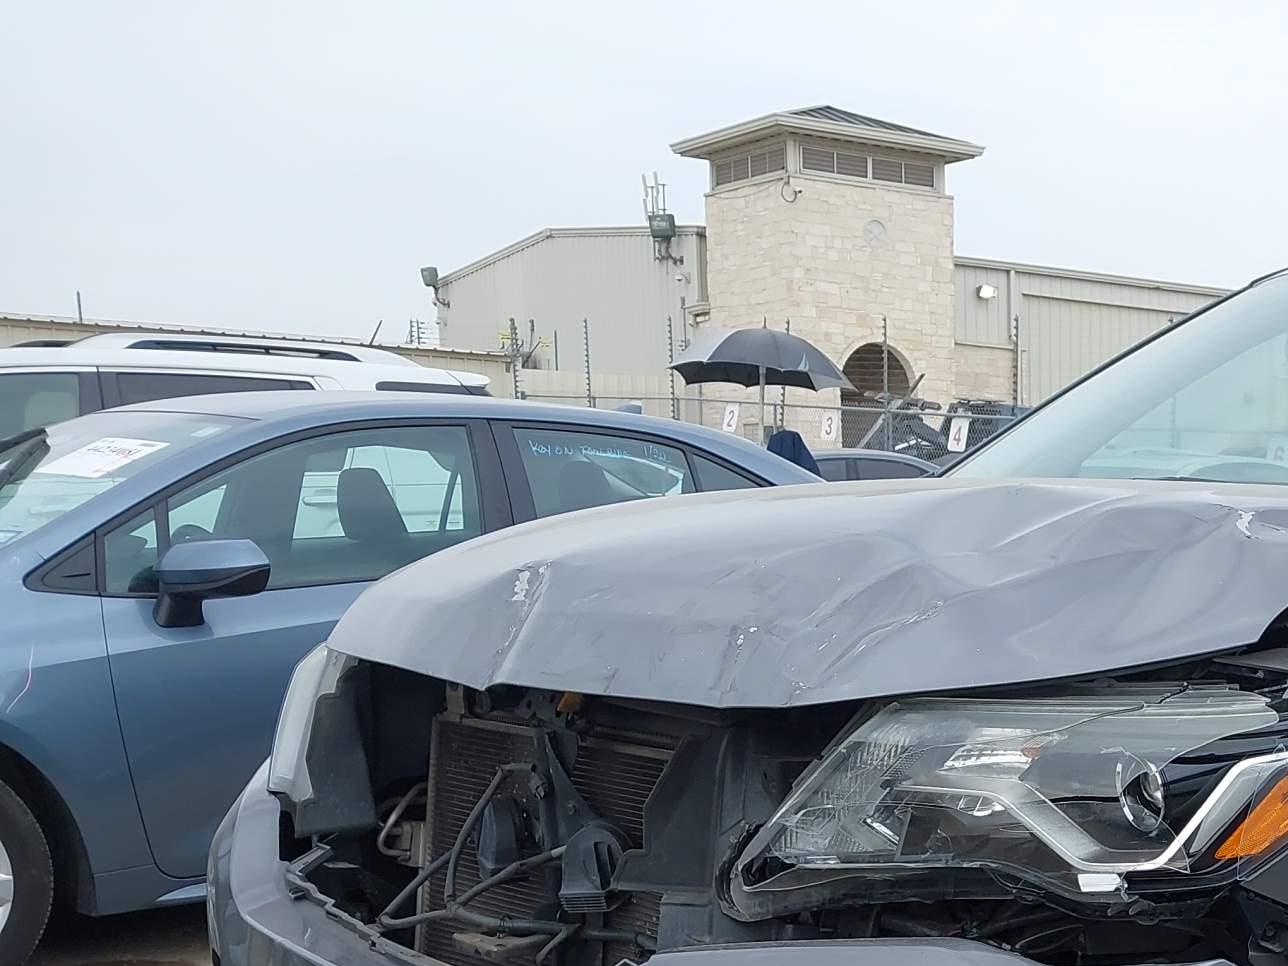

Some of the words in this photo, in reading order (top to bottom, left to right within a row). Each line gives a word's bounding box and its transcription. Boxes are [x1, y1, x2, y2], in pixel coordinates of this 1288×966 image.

[726, 409, 735, 429] 2
[825, 416, 833, 436] 3
[952, 425, 962, 446] 4
